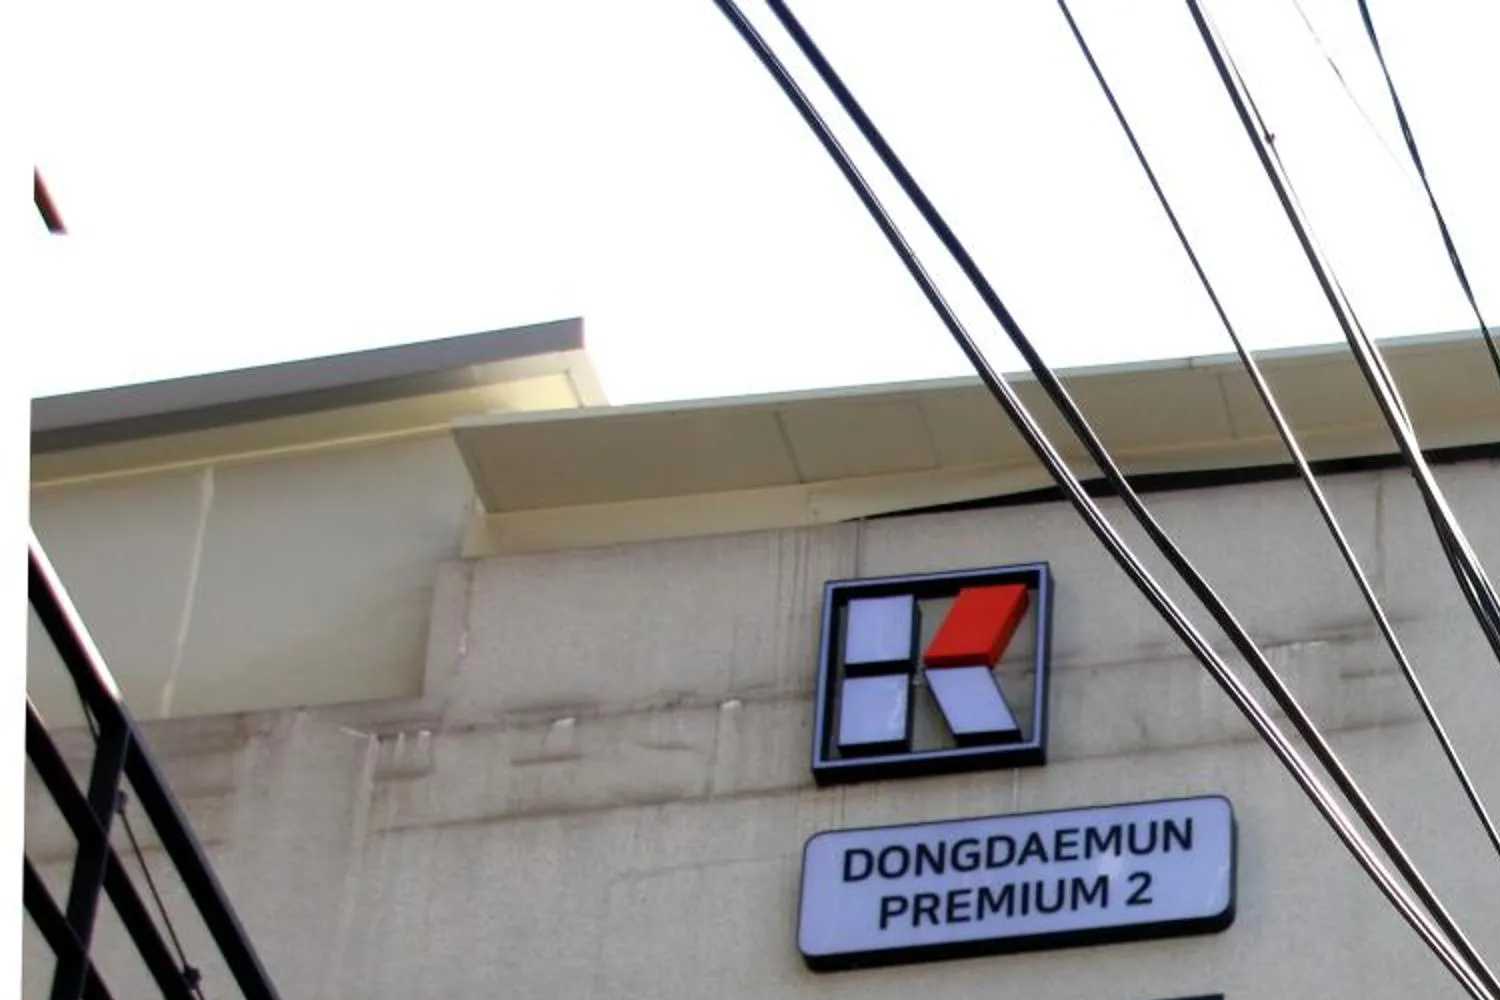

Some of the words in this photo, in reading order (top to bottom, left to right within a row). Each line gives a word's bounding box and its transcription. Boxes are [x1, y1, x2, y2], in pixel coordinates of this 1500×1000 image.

[842, 818, 1194, 883] DONGDAEMUN
[878, 875, 1110, 930] PREMIUM
[1126, 872, 1154, 906] 2
